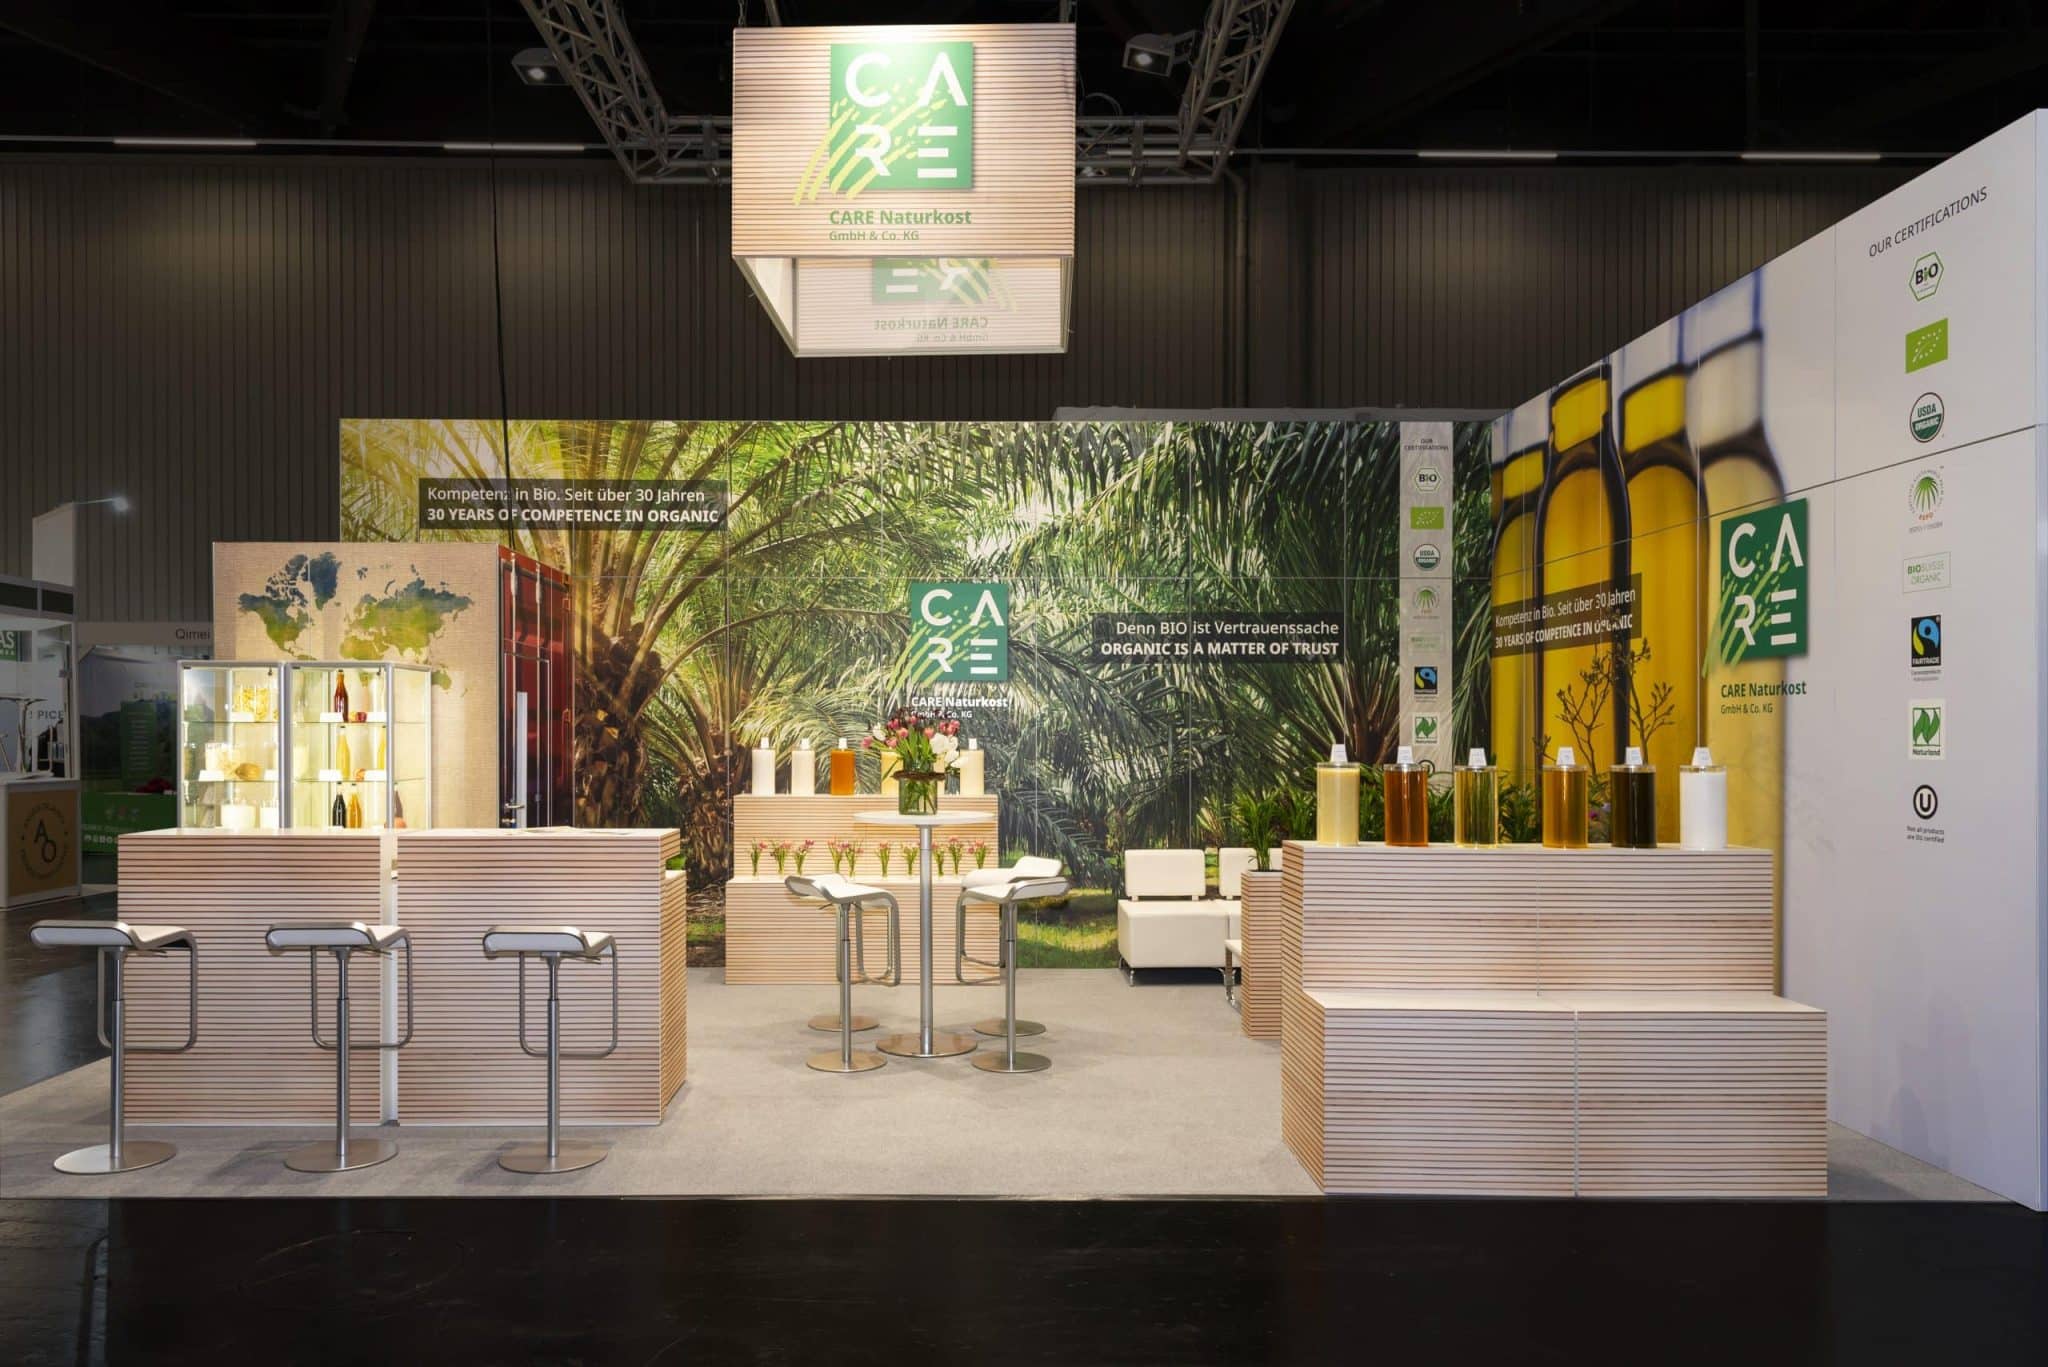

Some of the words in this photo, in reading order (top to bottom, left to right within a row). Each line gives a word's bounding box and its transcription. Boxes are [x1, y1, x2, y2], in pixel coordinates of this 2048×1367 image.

[829, 210, 874, 225] CARE
[880, 208, 972, 225] Naturkost
[1869, 236, 1892, 257] OUR
[1894, 186, 1987, 245] CERTIFICATIONS
[829, 230, 866, 241] GmbH
[868, 230, 878, 241] &
[881, 230, 901, 241] Co.
[903, 230, 920, 241] KG
[1917, 403, 1937, 418] USDA
[515, 488, 529, 501] in
[533, 488, 560, 501] Bio.
[564, 488, 593, 501] Seit
[597, 488, 632, 501] über
[635, 489, 654, 501] 30
[656, 489, 704, 505] Jahren
[427, 508, 445, 521] 30
[449, 508, 495, 521] YEARS
[498, 509, 518, 521] OF
[521, 509, 622, 522] COMPETENCE
[626, 510, 643, 522] IN
[647, 510, 719, 523] ORGANIC
[1495, 610, 1532, 629] Kompetenz
[1533, 608, 1541, 620] in
[1542, 605, 1555, 620] Bio.
[1557, 599, 1573, 616] Seit
[1574, 595, 1593, 613] über
[1595, 592, 1606, 609] 30
[1607, 589, 1635, 608] Jahren
[1116, 622, 1156, 634] Denn
[1160, 622, 1187, 634] BIO
[1193, 621, 1211, 634] ist
[1215, 621, 1339, 634] Vertrauenssache
[1495, 637, 1503, 649] 30
[1504, 632, 1524, 647] YEARS
[1525, 631, 1535, 643] OF
[1535, 623, 1582, 643] COMPETENCE
[1583, 621, 1593, 635] IN
[1101, 642, 1171, 655] ORGANIC
[1174, 642, 1189, 655] IS
[1193, 642, 1204, 655] A
[1207, 642, 1265, 655] MATTER
[1269, 642, 1289, 655] OF
[1292, 642, 1339, 655] TRUST
[1721, 683, 1747, 698] CARE
[1749, 680, 1807, 697] Naturkost
[911, 696, 944, 707] CARE
[945, 696, 1008, 707] Naturkost
[1721, 704, 1742, 715] GmbH
[1743, 704, 1749, 714] &
[1750, 704, 1760, 714] Co.
[1762, 703, 1773, 713] KG
[948, 710, 959, 718] Co.
[961, 710, 972, 718] KG
